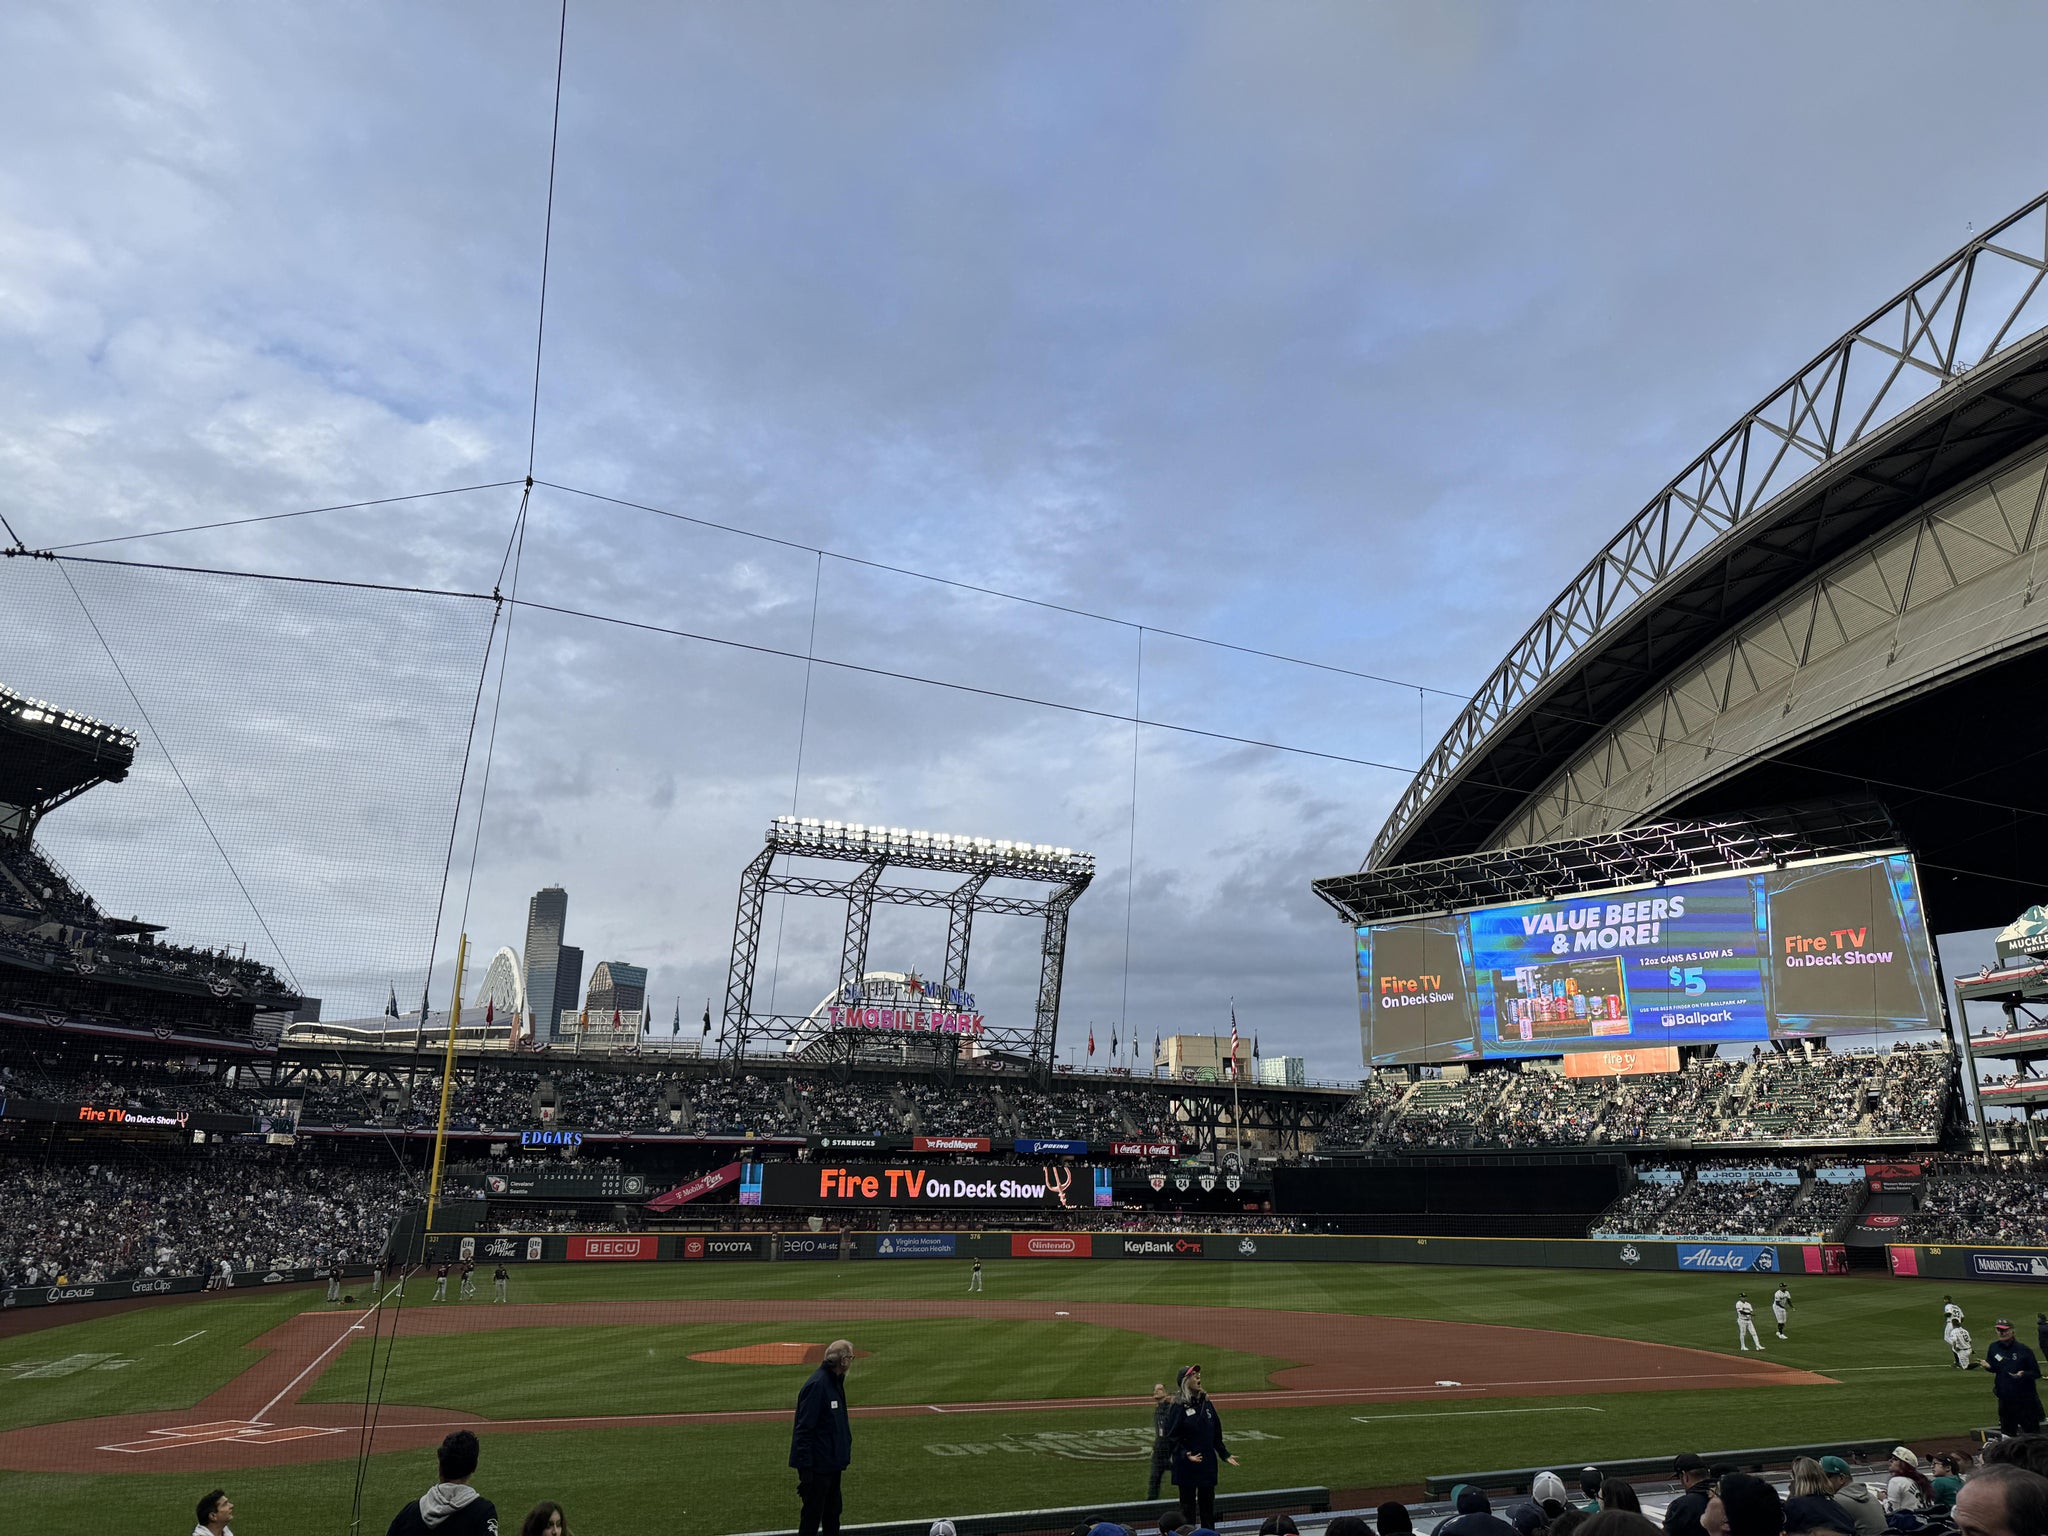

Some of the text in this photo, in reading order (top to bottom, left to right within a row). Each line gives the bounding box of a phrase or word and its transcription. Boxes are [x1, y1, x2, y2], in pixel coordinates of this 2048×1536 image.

[1521, 895, 1685, 936] VALUE BEERS
[1551, 922, 1661, 955] & MORE!
[1785, 927, 1867, 953] Fire TV
[1640, 948, 1734, 966] 12oz CANS AS LOW AS
[1786, 951, 1893, 967] On Deck Show
[1380, 975, 1441, 994] Fire TV
[1669, 966, 1706, 997] $5
[844, 980, 976, 1008] SEATTLE MARINERS
[1381, 992, 1454, 1009] On Deck Show
[828, 1006, 985, 1035] T-MOBILE PARK
[1676, 1010, 1733, 1025] Ballpark
[1603, 1053, 1636, 1065] fire tv
[79, 1107, 177, 1125] Fire TV On Deck Show
[832, 1139, 876, 1147] STARBUCKS
[682, 1182, 704, 1197] Mobile
[701, 1174, 723, 1189] Pen
[820, 1168, 1046, 1198] Fire TV On Deck Show
[1152, 1180, 1162, 1188] 42
[1178, 1180, 1188, 1188] 24
[1229, 1181, 1238, 1189] 51
[485, 1241, 518, 1257] Miller
[590, 1243, 636, 1253] BECU
[708, 1242, 752, 1251] TOYOTA
[895, 1238, 920, 1246] Virginia
[1032, 1241, 1071, 1249] Nintendo
[1124, 1241, 1174, 1254] KeyBank
[1241, 1241, 1253, 1249] 50
[499, 1249, 516, 1257] TIME
[1623, 1248, 1637, 1258] 50
[1683, 1248, 1744, 1269] Alaska
[61, 1288, 94, 1298] LEXUS
[132, 1280, 172, 1293] Great Clips
